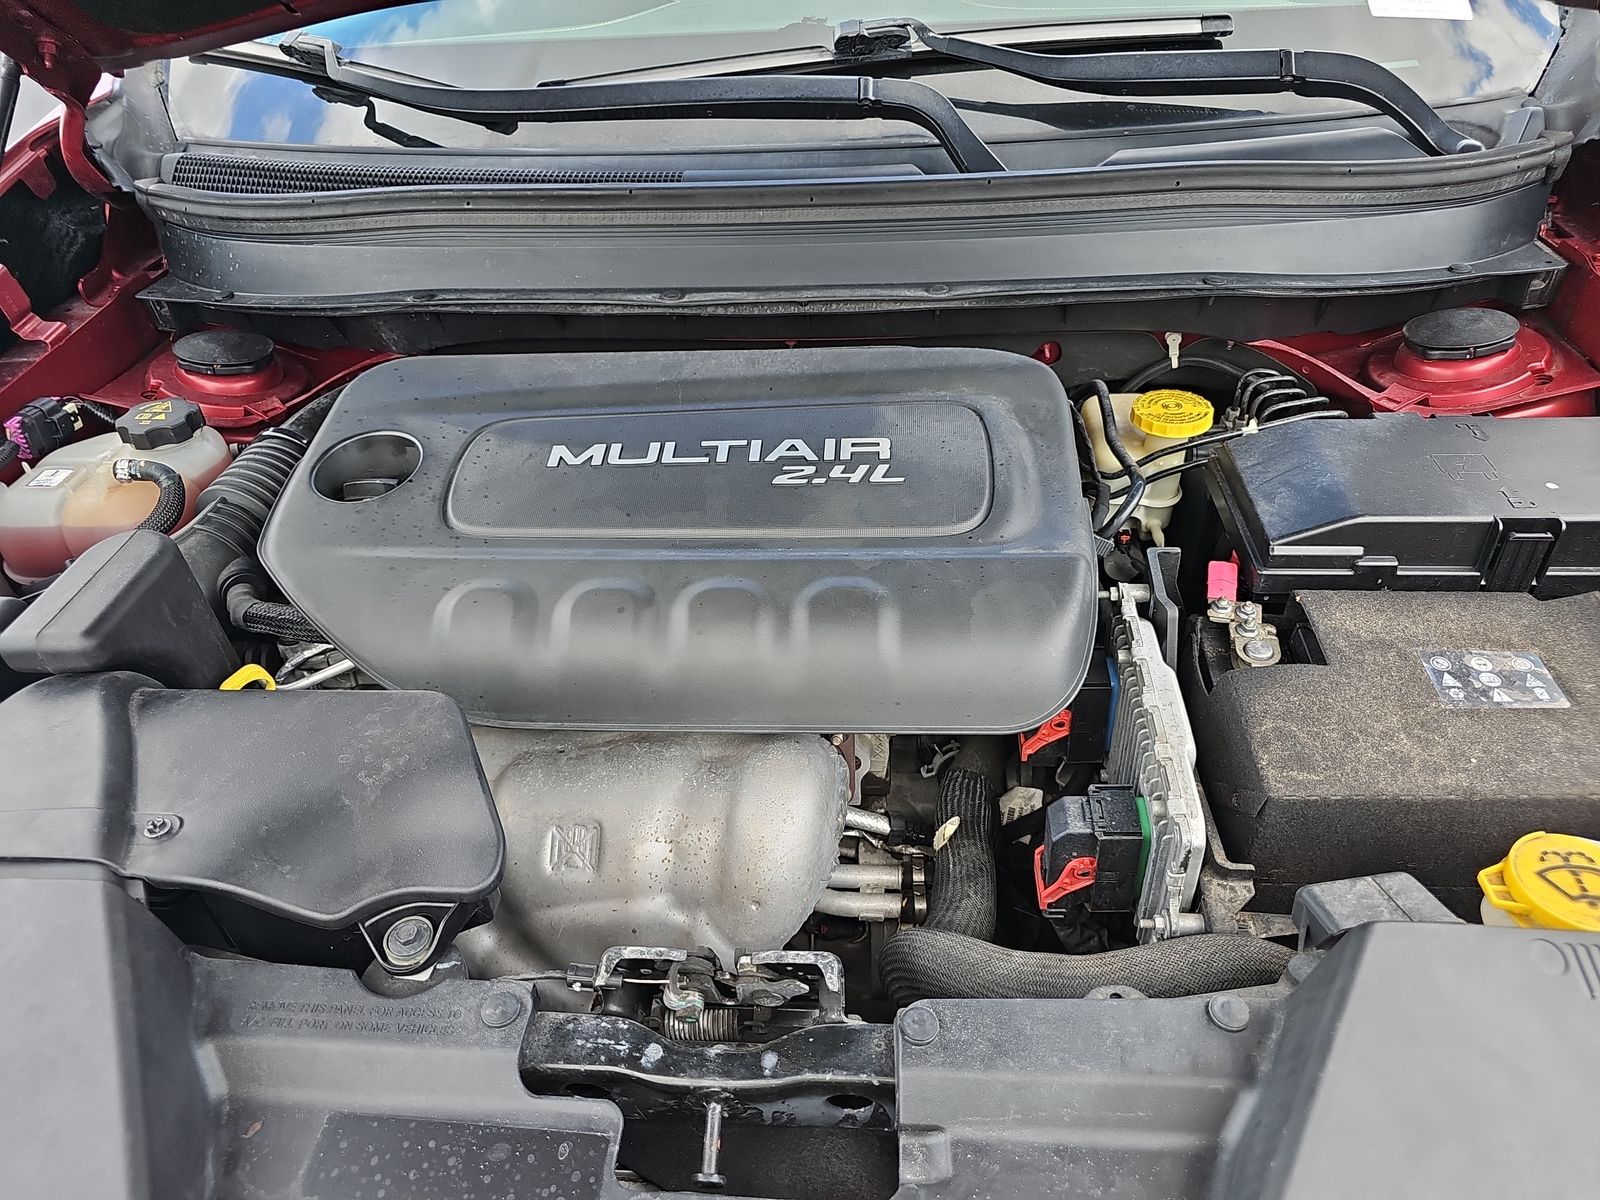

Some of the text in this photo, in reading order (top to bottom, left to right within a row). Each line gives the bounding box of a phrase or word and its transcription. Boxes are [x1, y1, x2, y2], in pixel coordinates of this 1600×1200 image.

[546, 437, 892, 468] MULTIAIR
[770, 464, 906, 486] 2.4L
[300, 1002, 327, 1015] THIS
[329, 1003, 367, 1016] PANEL
[369, 1005, 394, 1018] FOR
[396, 1007, 444, 1019] ACCESS
[299, 1018, 331, 1031] PORT
[334, 1019, 353, 1032] ON
[355, 1021, 393, 1033] SOME
[397, 1022, 455, 1036] VEHICLES
